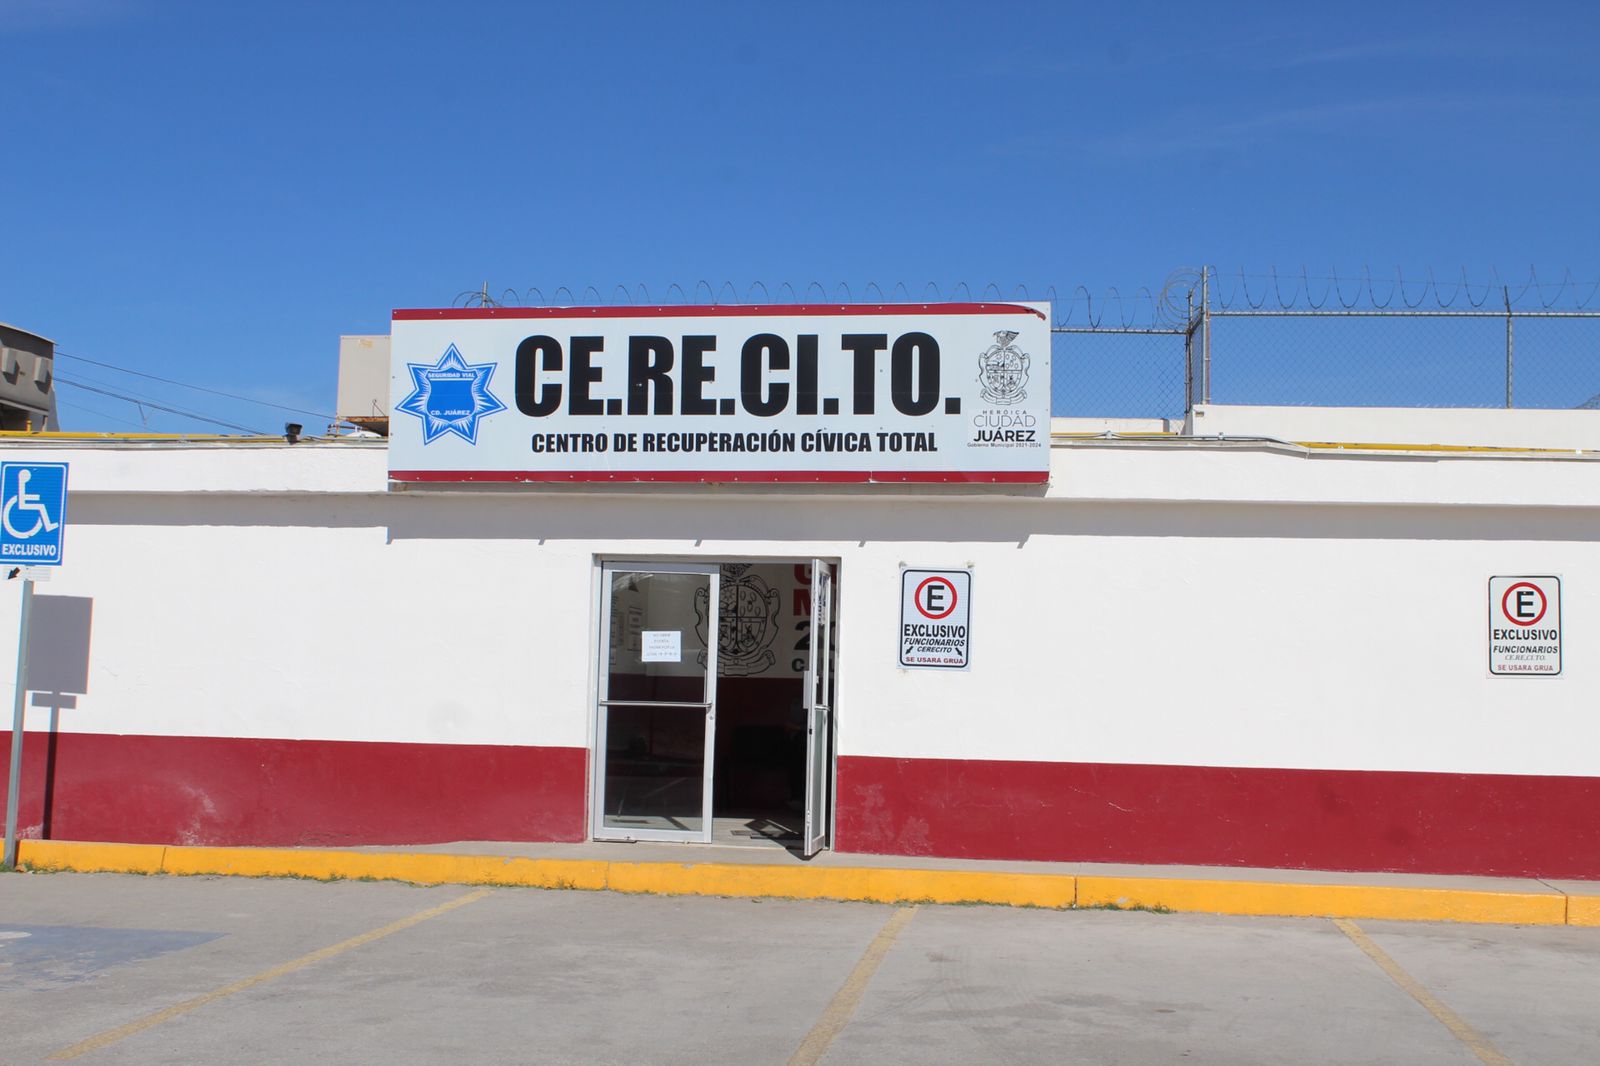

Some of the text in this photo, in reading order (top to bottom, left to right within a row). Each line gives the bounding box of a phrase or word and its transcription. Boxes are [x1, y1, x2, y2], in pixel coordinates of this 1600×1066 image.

[515, 331, 961, 418] CE.RE.CI.TO.
[973, 414, 1036, 427] CIUDAD
[531, 429, 938, 453] CENTRO DE RECUPERACIÓN CÍVICA TOTAL
[973, 426, 1036, 442] JUÁREZ
[2, 543, 56, 556] EXCLUSIVO
[927, 585, 945, 611] E
[1516, 591, 1535, 617] E
[904, 624, 966, 638] EXCLUSIVO
[1493, 629, 1558, 640] EXCLUSIVO
[904, 638, 965, 647] FUNCIONARIOS
[1493, 645, 1558, 653] FUNCIONARIOS
